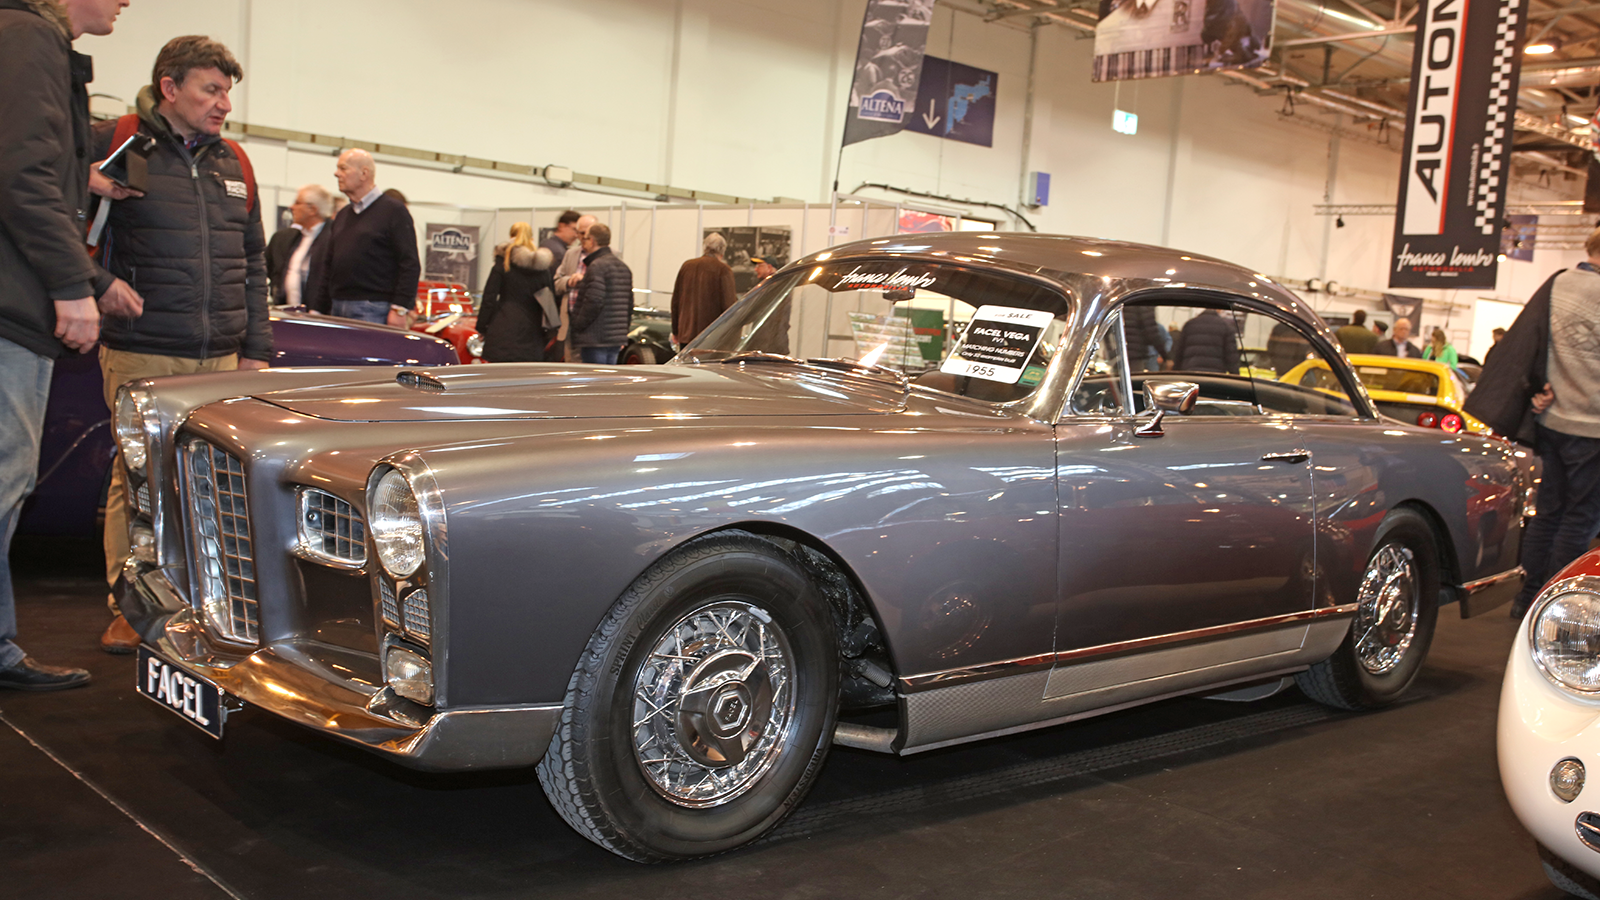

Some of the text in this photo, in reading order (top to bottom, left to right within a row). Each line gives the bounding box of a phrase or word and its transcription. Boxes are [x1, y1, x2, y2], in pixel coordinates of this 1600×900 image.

[861, 99, 902, 115] ALTENA
[433, 235, 469, 247] ALTENA
[1396, 242, 1494, 272] franco lembo
[833, 265, 889, 289] franco
[1007, 312, 1033, 320] SALE
[973, 327, 1030, 342] FACEL VEGA
[961, 343, 1025, 358] MATCHING NUMBERS
[965, 364, 996, 377] 1955
[609, 630, 637, 676] SPRINT
[147, 656, 211, 727] FACEL
[783, 748, 823, 809] VREDESTEIN
